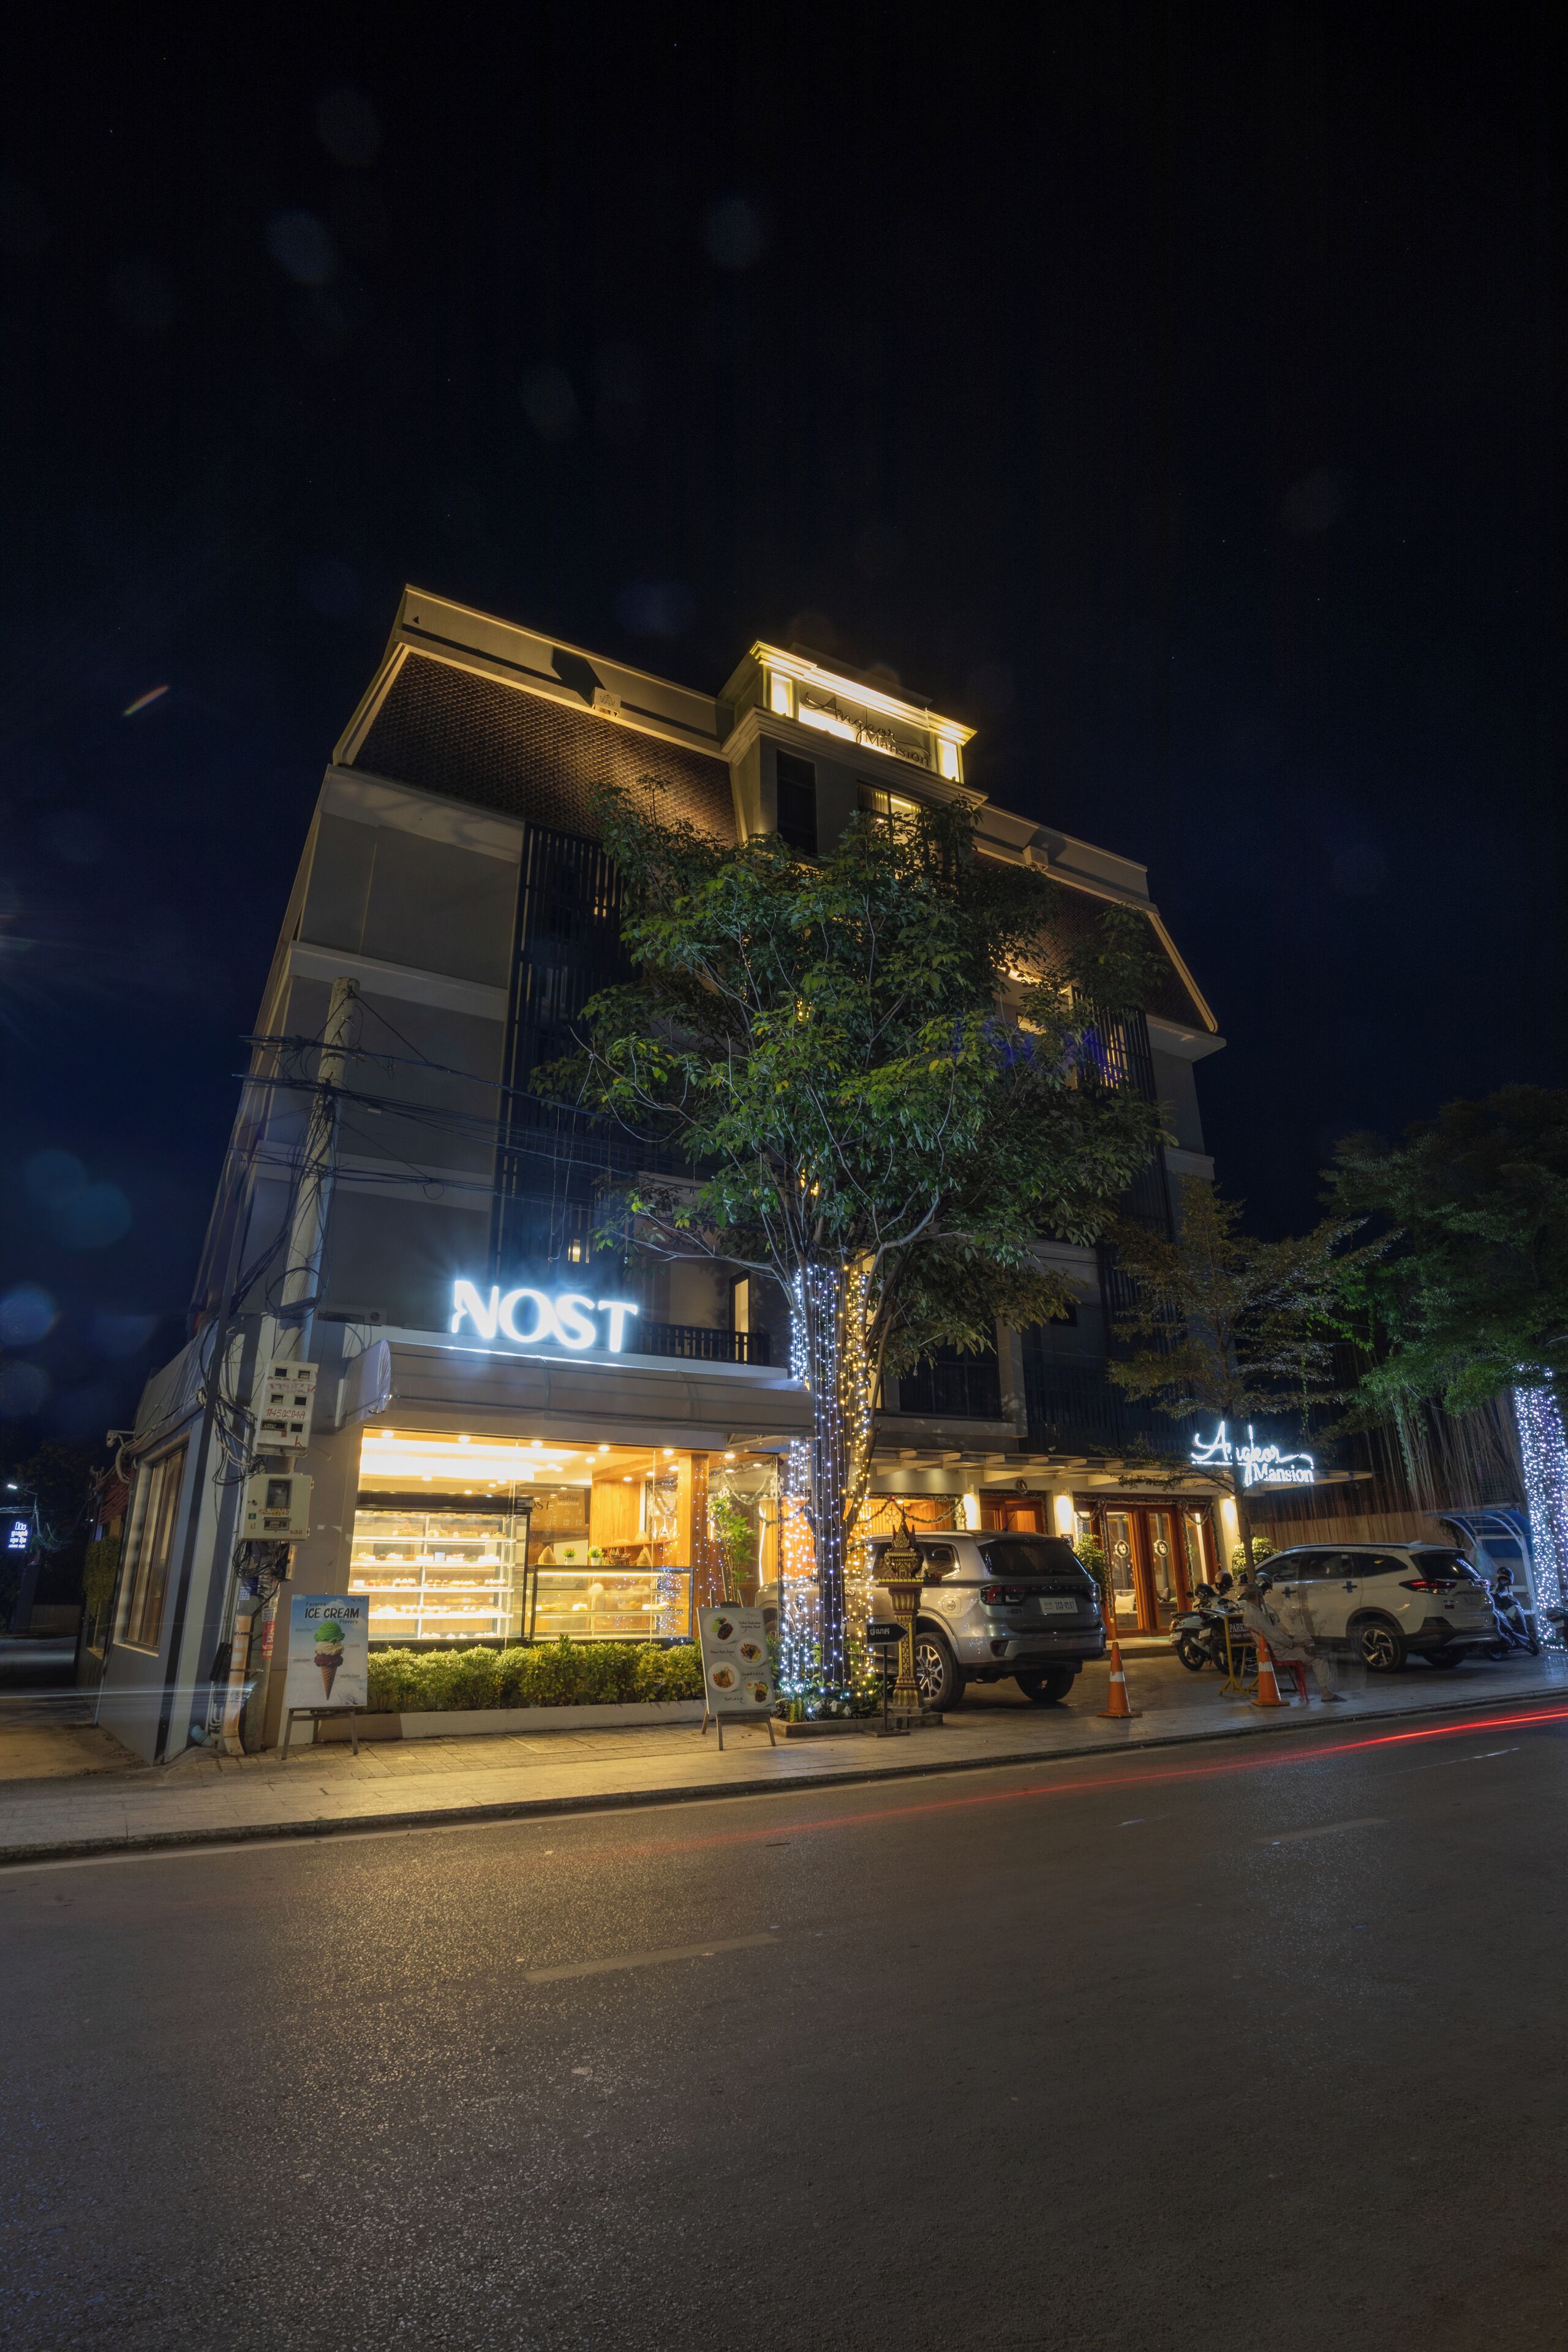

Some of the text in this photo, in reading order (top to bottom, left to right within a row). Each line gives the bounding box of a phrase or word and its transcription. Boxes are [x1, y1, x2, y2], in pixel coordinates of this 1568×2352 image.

[801, 692, 931, 758] Angkor
[865, 734, 929, 767] Mansion
[452, 1280, 638, 1352] NOST
[1253, 1463, 1314, 1483] Mansion
[304, 1607, 360, 1619] ICE CREAM
